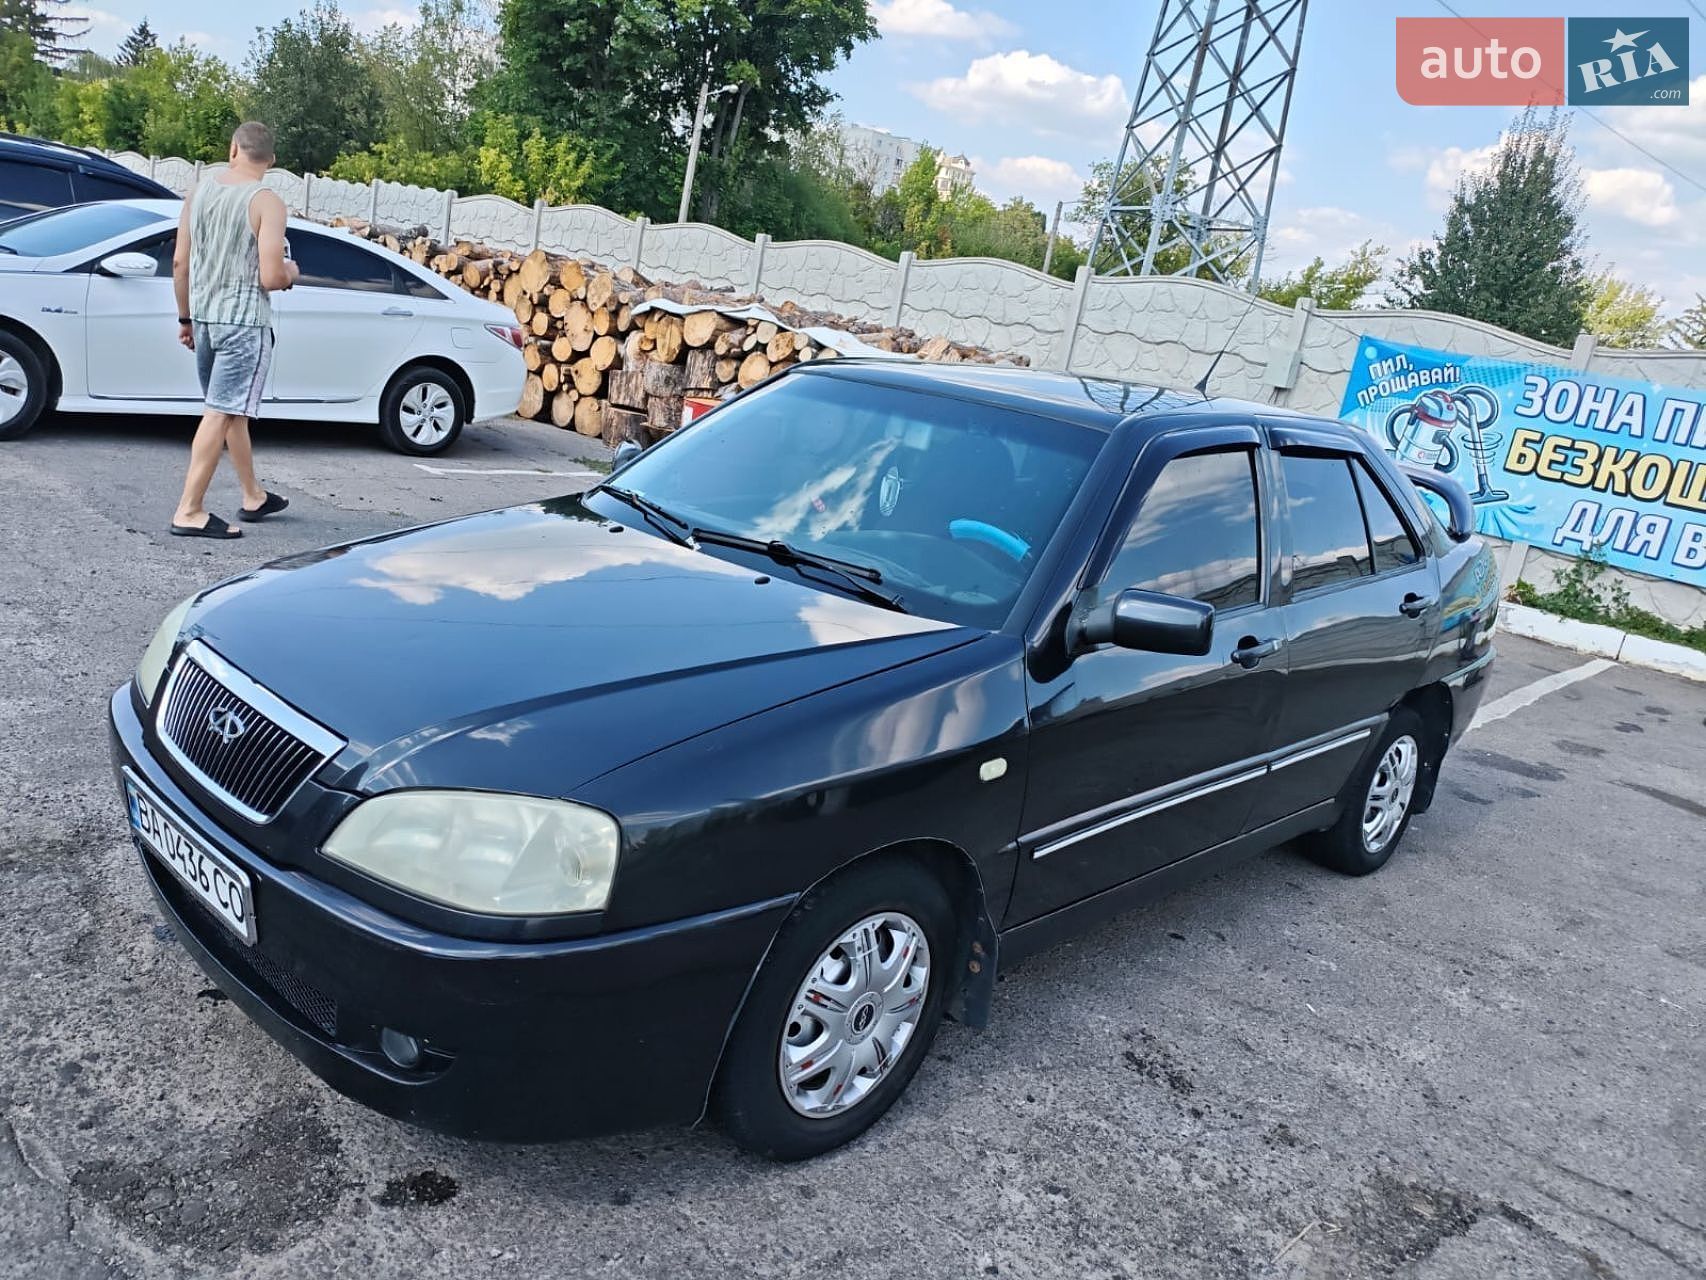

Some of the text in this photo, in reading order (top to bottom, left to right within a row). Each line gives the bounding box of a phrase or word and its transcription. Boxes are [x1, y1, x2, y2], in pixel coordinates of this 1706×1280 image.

[1357, 362, 1461, 407] ПРОЩАВАЙ!
[1368, 353, 1414, 380] ПИЛ,
[1514, 375, 1646, 438] ЗОНА
[1552, 500, 1673, 561] ДЛЯ
